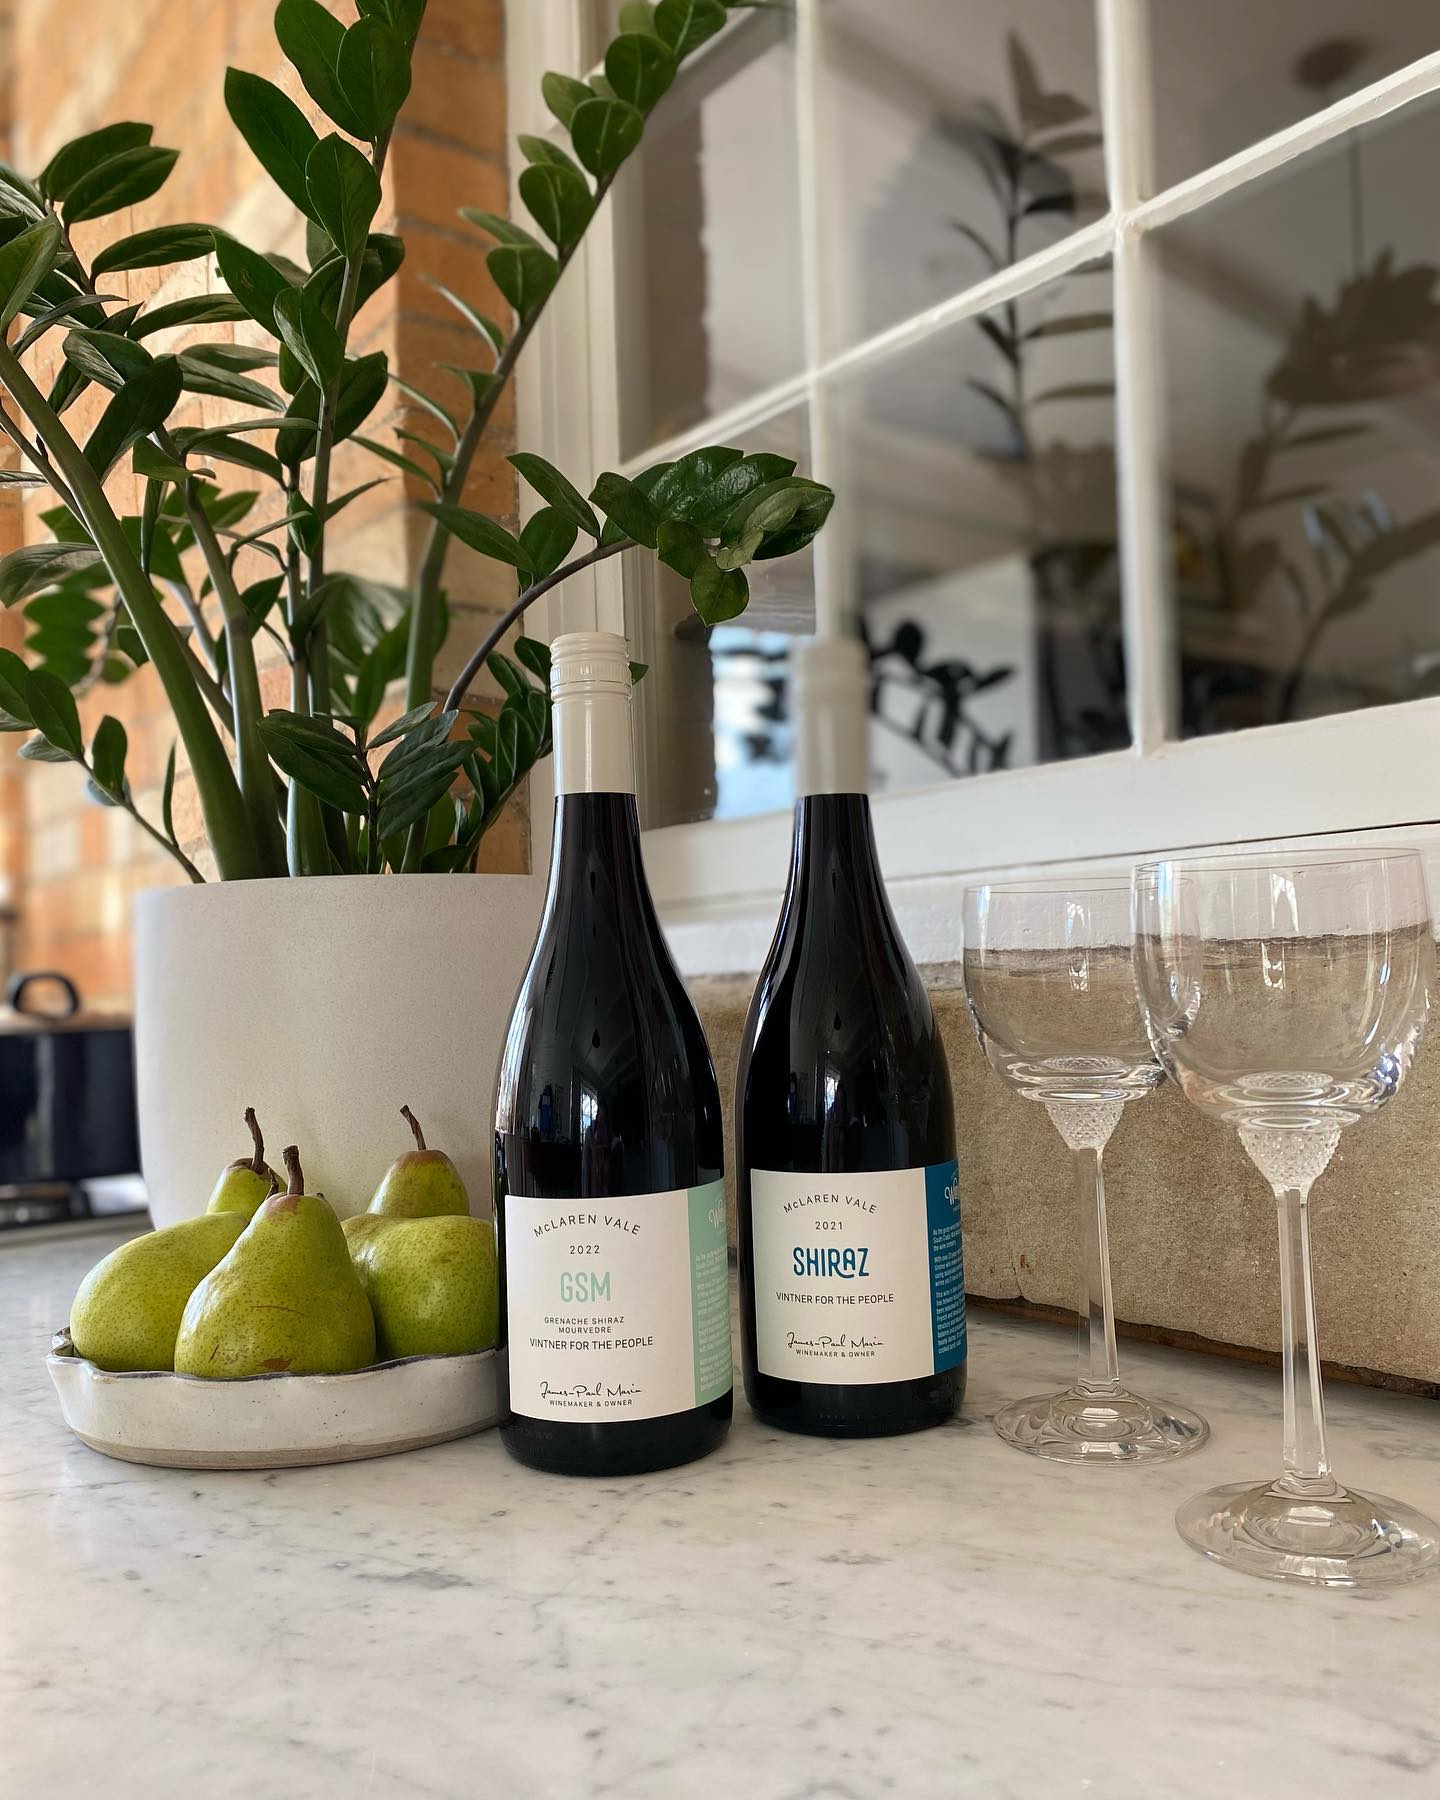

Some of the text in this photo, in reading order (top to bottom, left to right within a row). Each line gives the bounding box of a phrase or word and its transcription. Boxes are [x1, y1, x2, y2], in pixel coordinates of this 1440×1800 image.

[783, 1193, 877, 1214] McLAREN VALE
[533, 1214, 641, 1238] McLAREN VALE
[815, 1221, 843, 1230] 2021
[569, 1244, 600, 1255] 2022
[792, 1246, 870, 1279] SHIRAZ
[560, 1271, 611, 1303] GSM
[775, 1291, 894, 1305] VINTNER FOR THE PEOPLE
[544, 1316, 625, 1325] GRENACHE SHIRAZ
[558, 1326, 612, 1334] MOURVEDRE
[529, 1336, 653, 1351] VINTNER FOR THE PEOPLE
[796, 1349, 875, 1358] WINEMAKER & OWNER
[549, 1399, 594, 1408] WINEMAKER
[604, 1399, 633, 1407] OWNER
